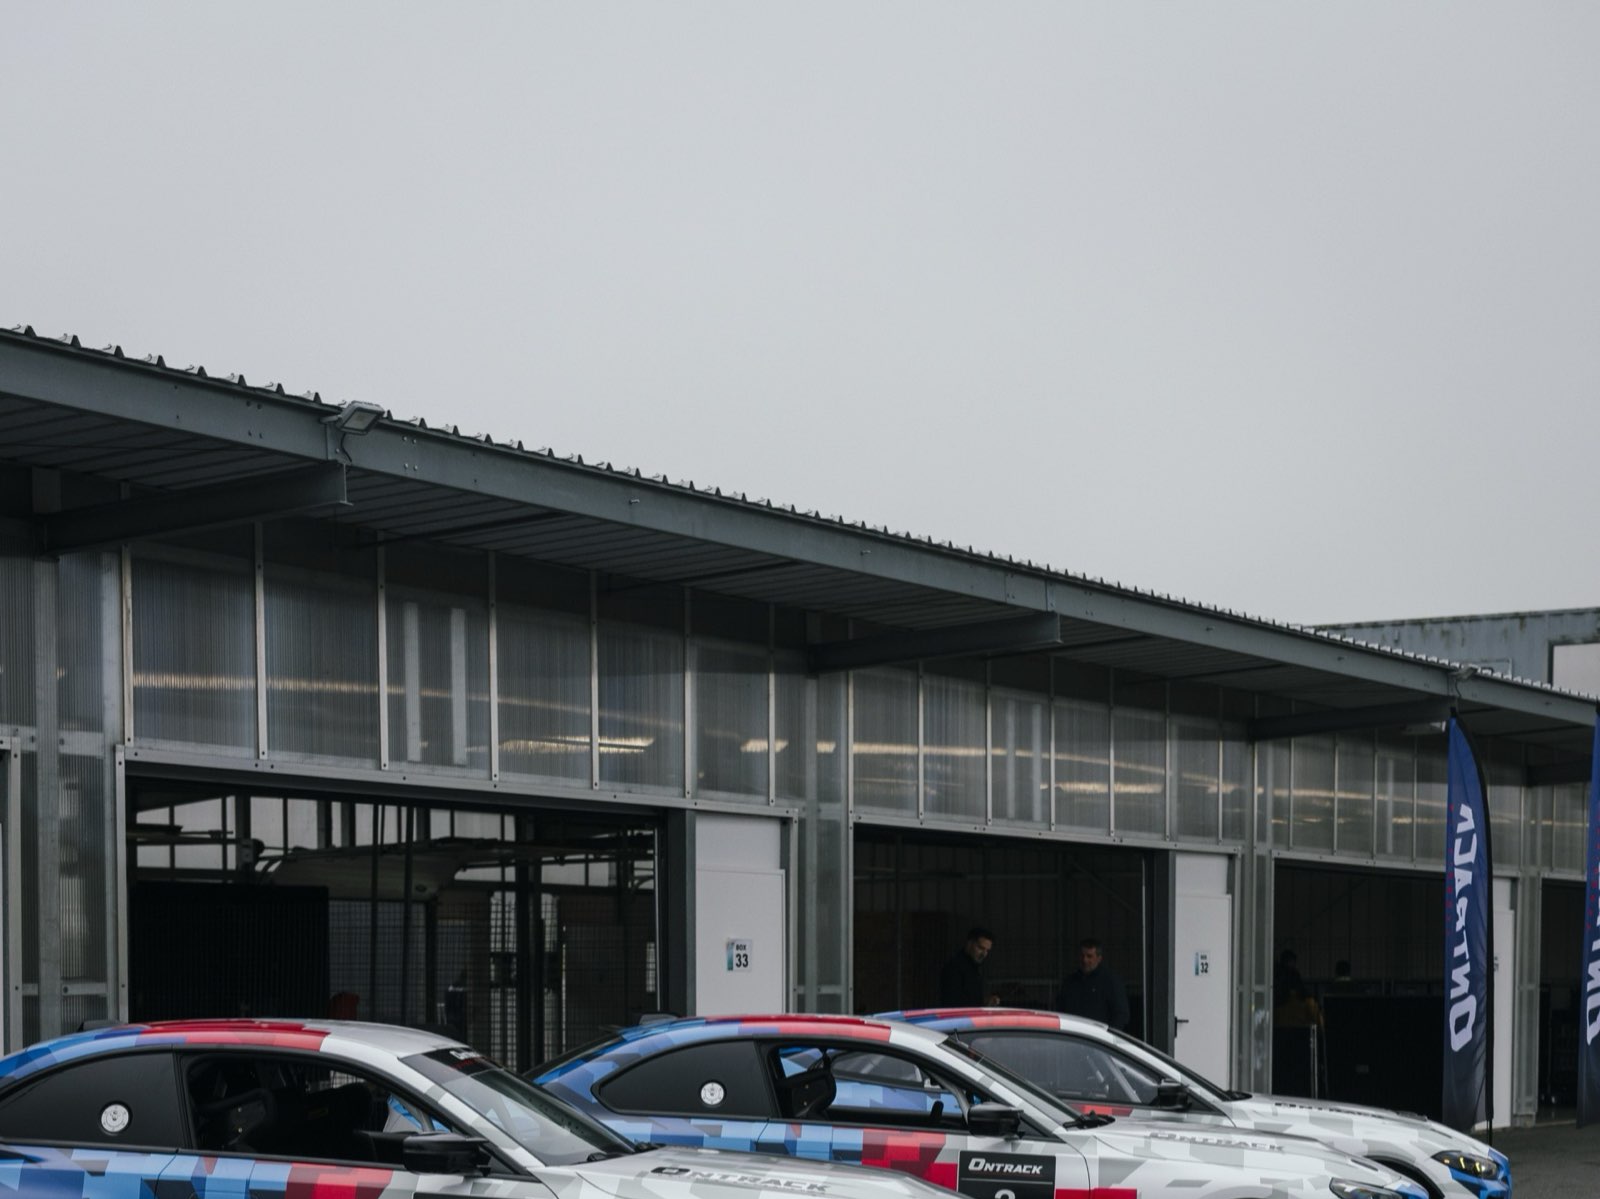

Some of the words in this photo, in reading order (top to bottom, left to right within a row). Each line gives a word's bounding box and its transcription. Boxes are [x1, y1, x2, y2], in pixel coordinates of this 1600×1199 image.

[735, 953, 749, 968] 33
[968, 1158, 1043, 1174] ONTRACK
[651, 1166, 829, 1192] ONTRACK
